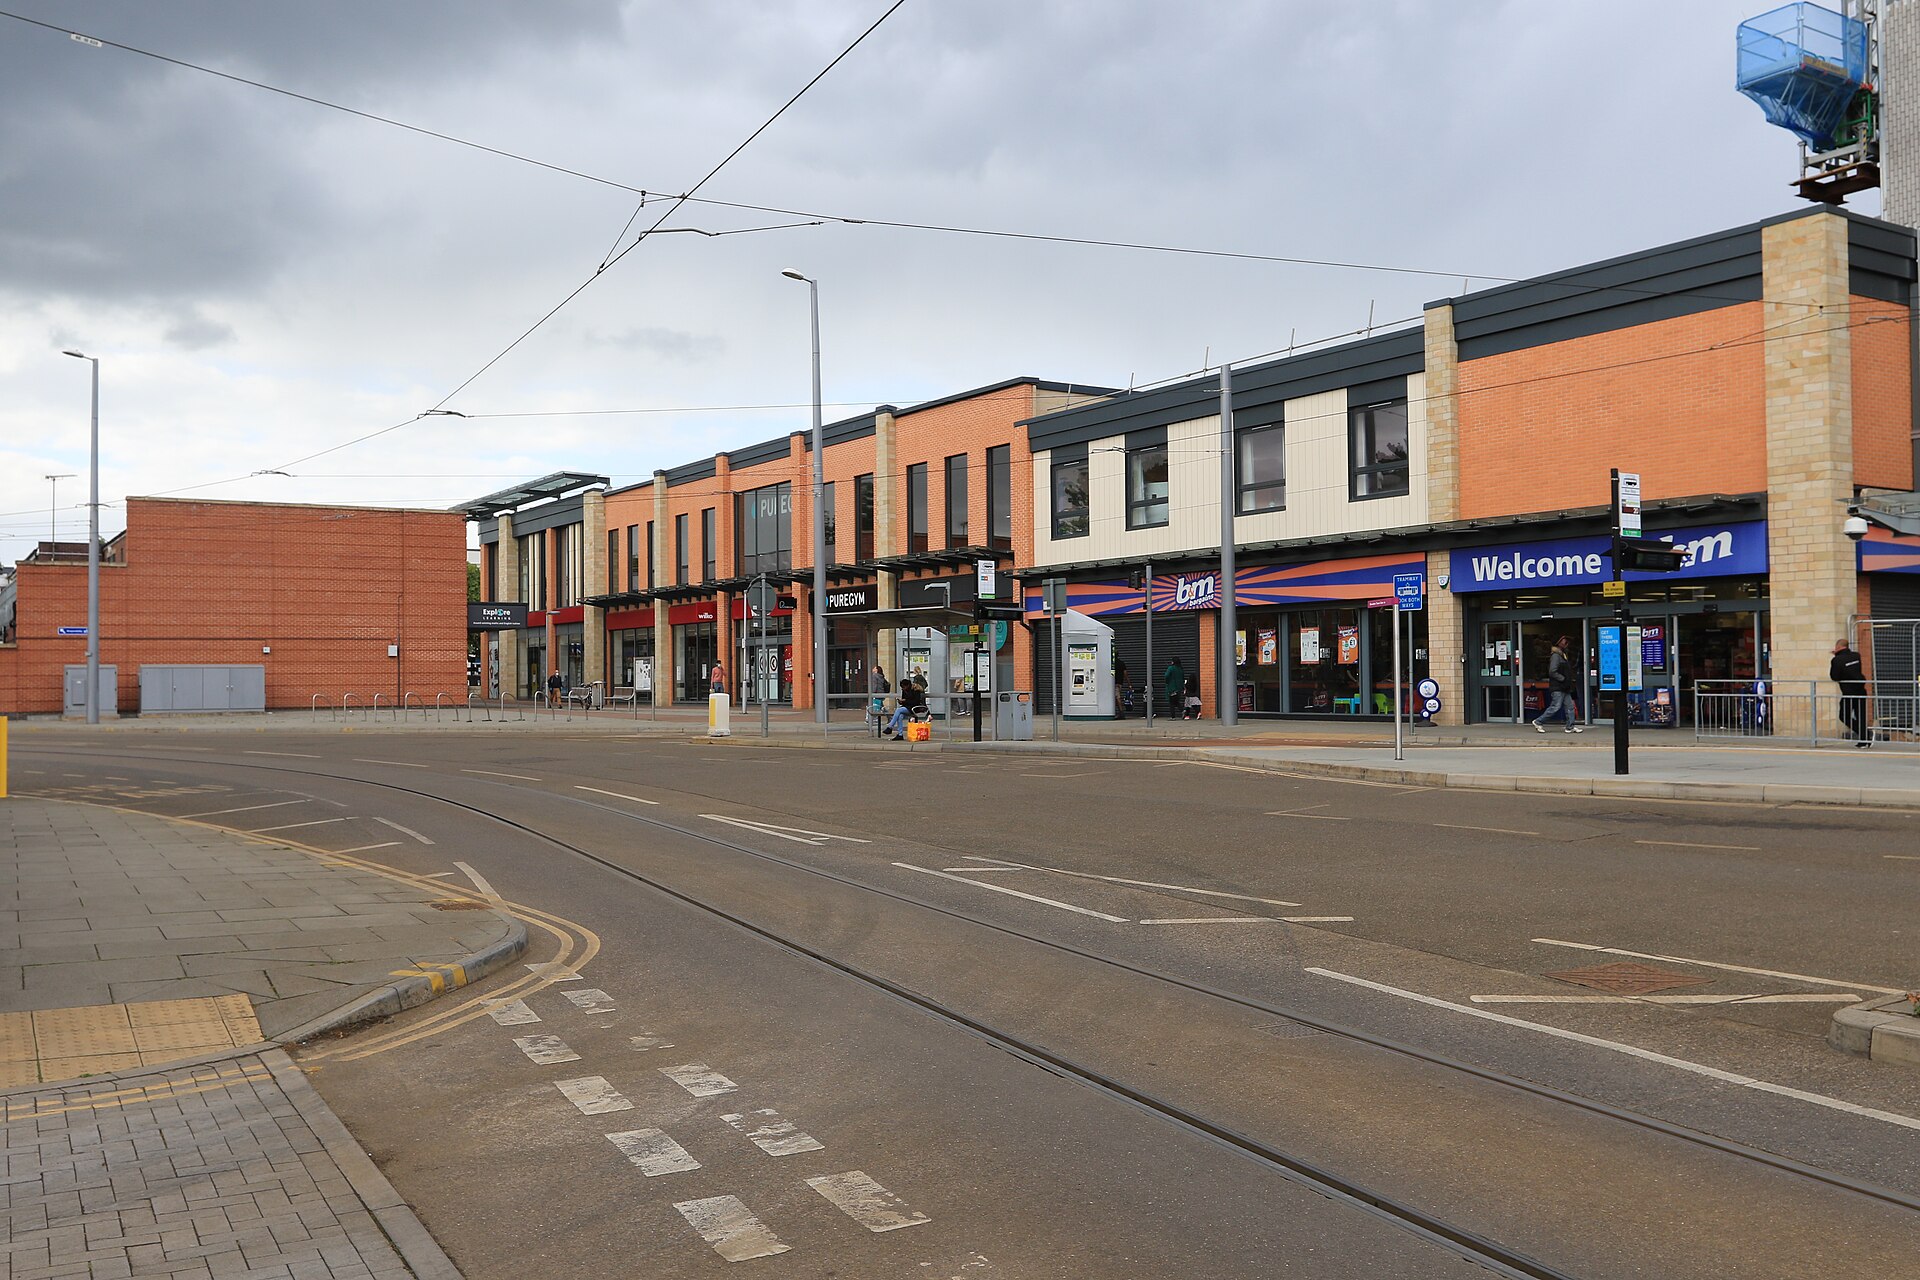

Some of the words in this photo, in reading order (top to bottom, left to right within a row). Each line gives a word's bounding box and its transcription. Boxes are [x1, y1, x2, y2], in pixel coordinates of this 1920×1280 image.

[1472, 552, 1601, 581] Welcome
[829, 591, 865, 608] PUREGYM
[483, 608, 511, 616] Explore
